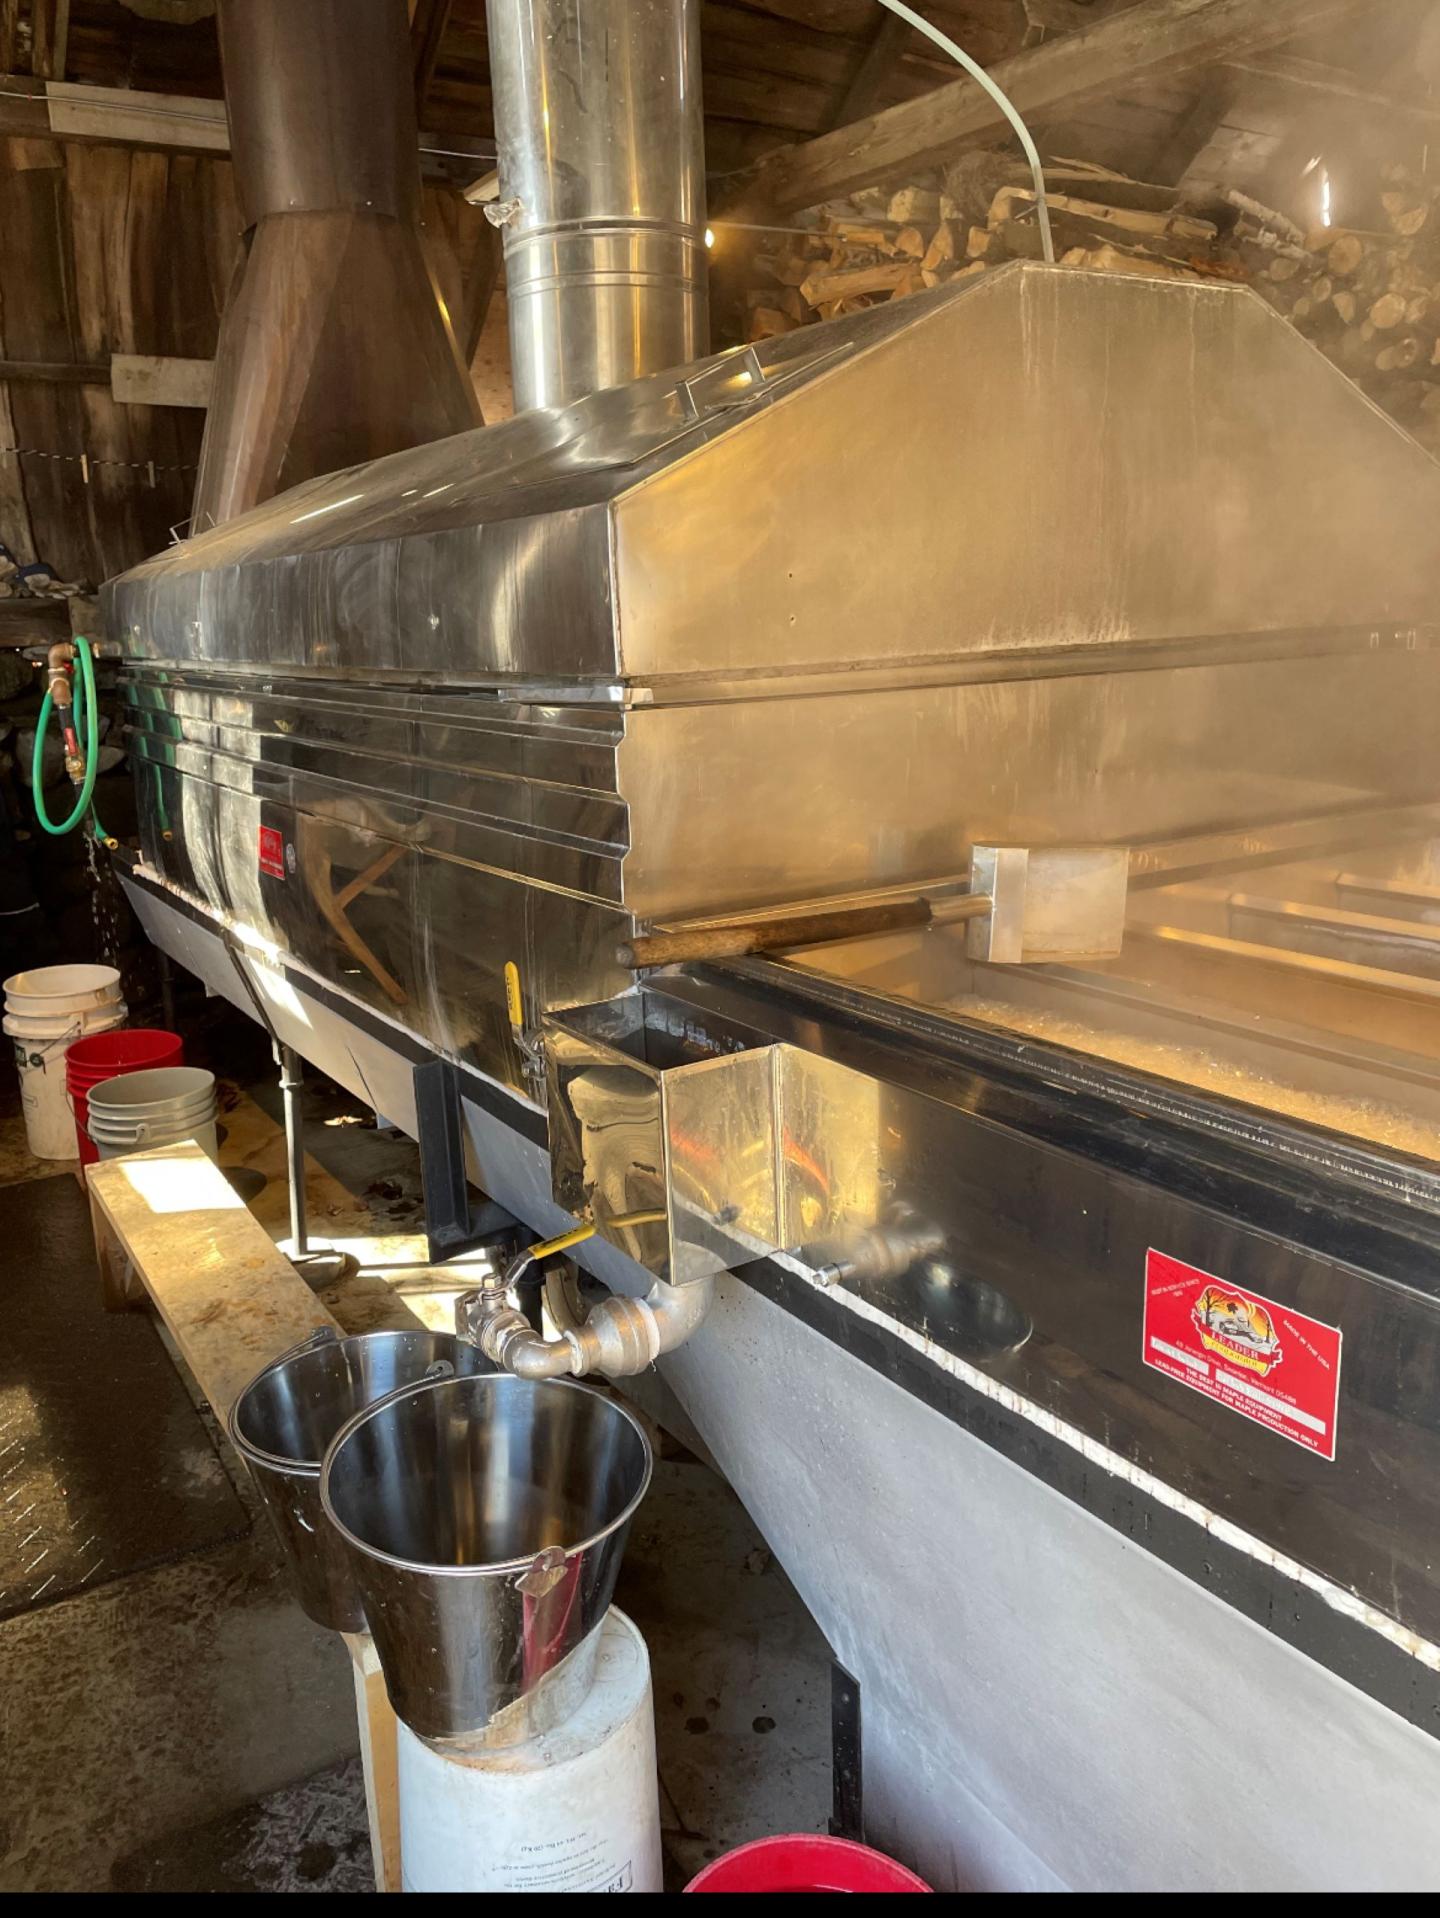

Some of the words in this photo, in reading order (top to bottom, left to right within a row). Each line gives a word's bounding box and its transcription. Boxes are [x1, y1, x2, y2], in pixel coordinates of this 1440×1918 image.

[1211, 1330, 1259, 1360] LEADER
[1283, 1320, 1300, 1338] MADE
[1299, 1336, 1307, 1345] IN
[1306, 1344, 1318, 1357] THE
[1317, 1355, 1330, 1370] USA
[1154, 1358, 1186, 1378] LEAD-FREE
[1185, 1374, 1221, 1397] EQUIPMENT
[1221, 1391, 1234, 1404] FOR
[1234, 1399, 1258, 1416] MAPLE
[1257, 1412, 1300, 1439] PRODUCTION
[1300, 1434, 1319, 1448] ONLY
[1186, 1367, 1198, 1377] THE
[1199, 1373, 1214, 1386] BEST
[1222, 1385, 1244, 1401] MAPLE
[1245, 1397, 1282, 1421] EQUIPMENT
